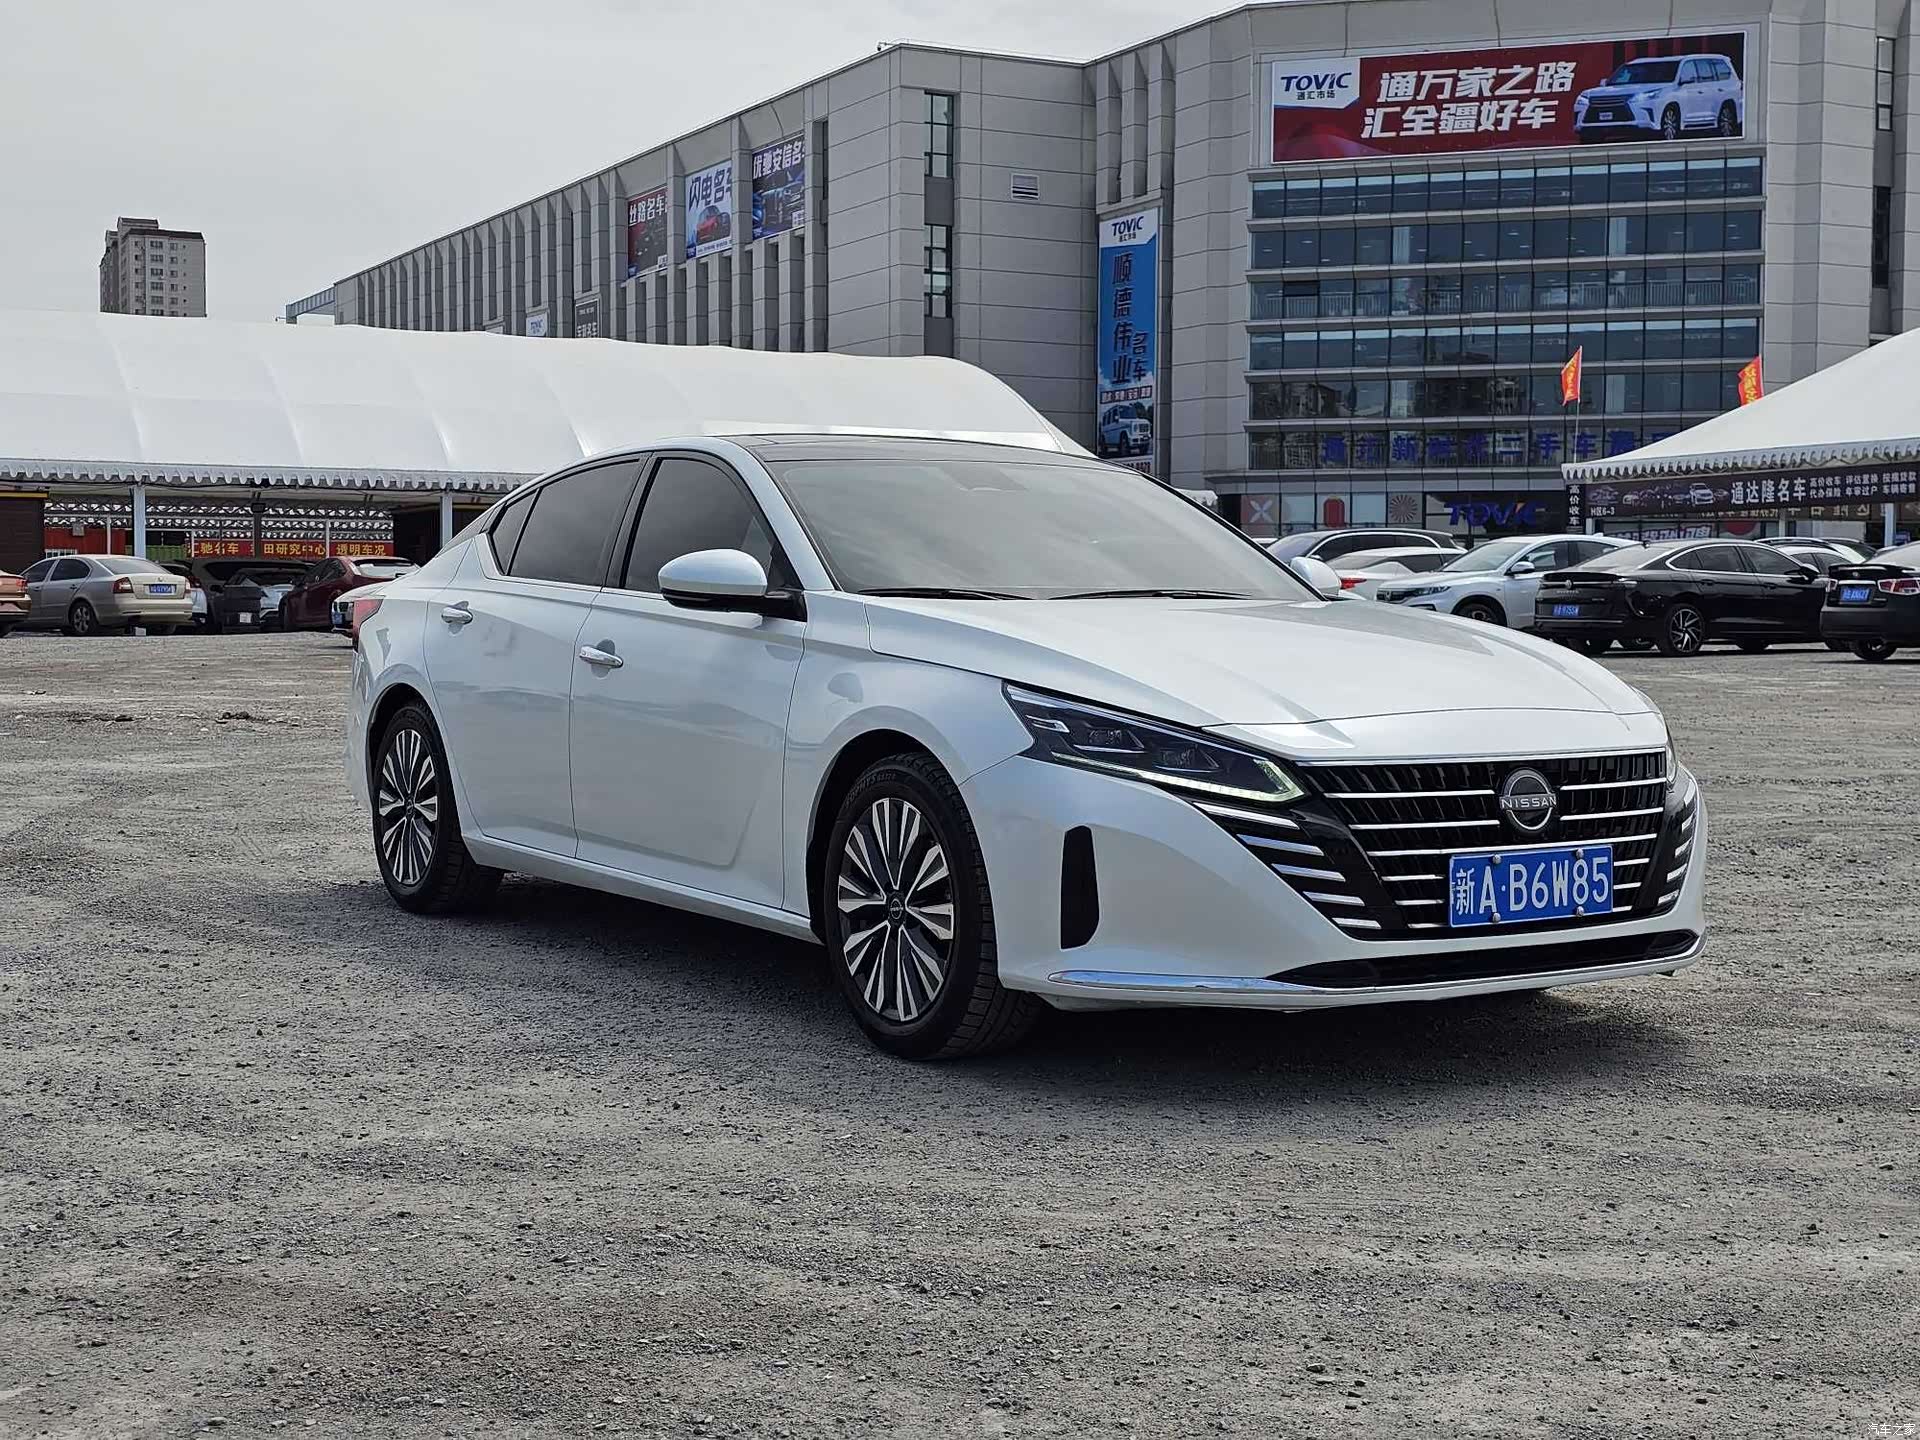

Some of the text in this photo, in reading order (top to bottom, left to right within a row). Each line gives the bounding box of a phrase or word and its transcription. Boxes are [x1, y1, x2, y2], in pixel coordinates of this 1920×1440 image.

[1376, 61, 1577, 103] 通万家之路
[1361, 98, 1558, 139] 汇全疆好车
[629, 191, 668, 227] 丝路名车
[1111, 252, 1133, 385] 顺德伟业
[1132, 331, 1148, 382] 名车
[1569, 484, 1580, 526] 高价收车
[1731, 476, 1807, 505] 通达隆名车
[336, 543, 387, 557] 透明车况
[1501, 794, 1557, 810] NISSAN
